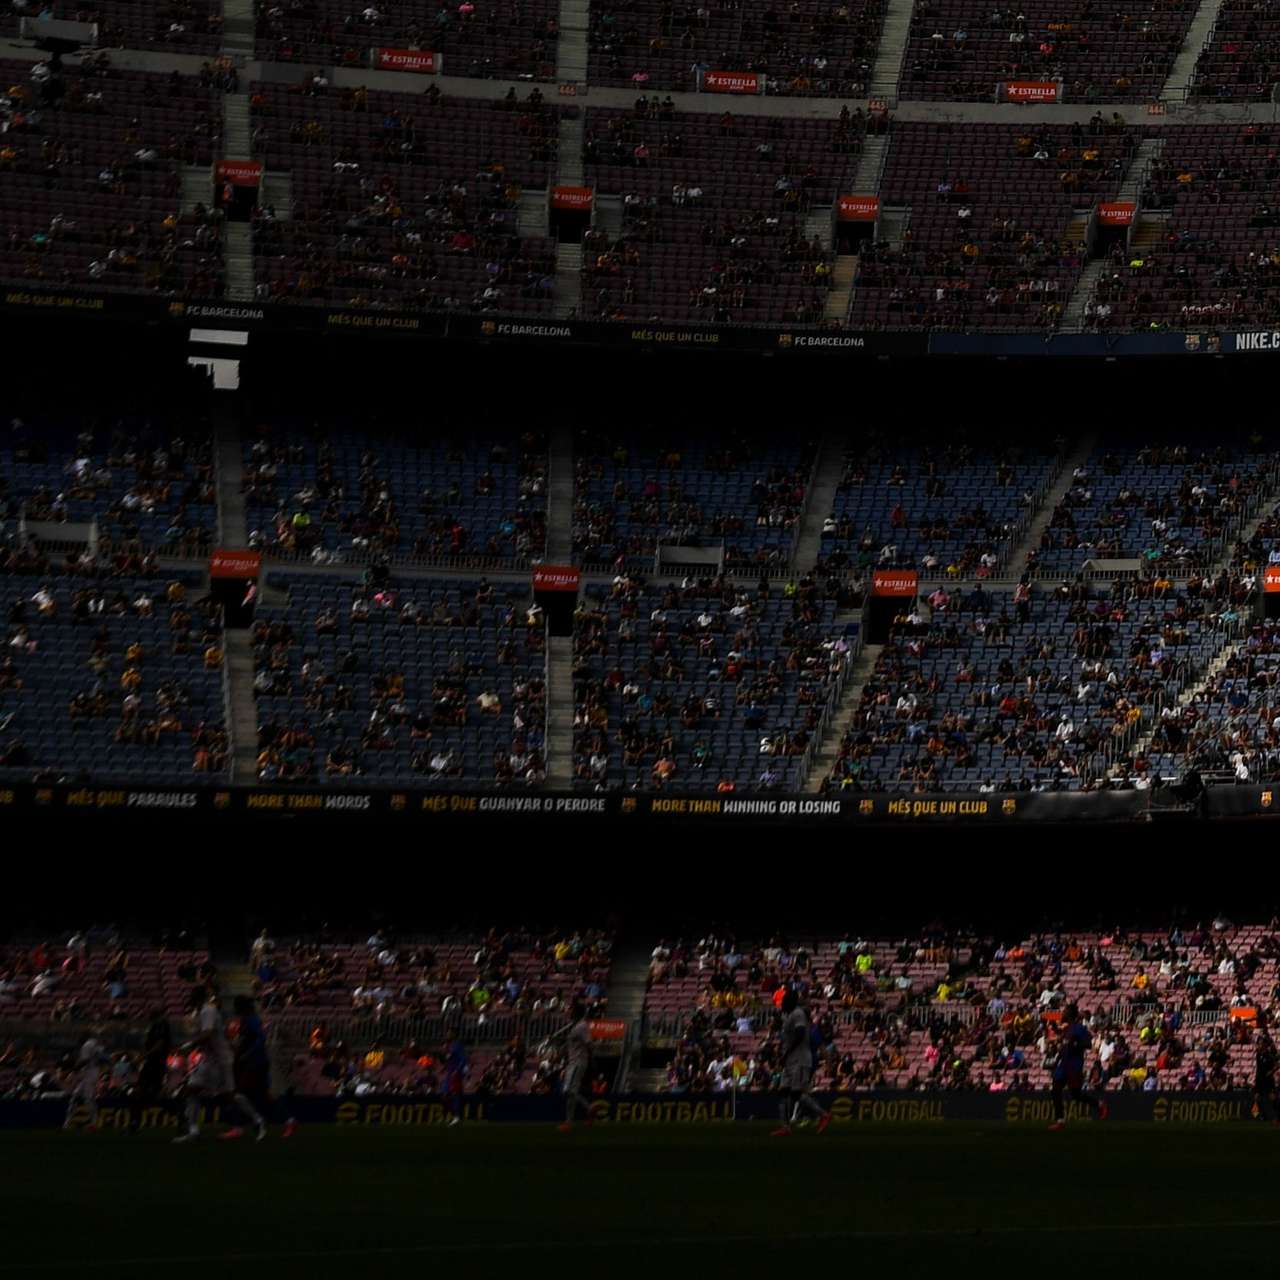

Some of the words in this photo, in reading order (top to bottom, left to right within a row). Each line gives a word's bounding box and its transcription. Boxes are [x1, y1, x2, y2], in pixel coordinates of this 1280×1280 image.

[718, 77, 757, 87] ESTRELLA
[1019, 87, 1056, 96] ESTRELLA
[498, 323, 511, 334] FC
[512, 324, 572, 337] BARCELONA
[795, 335, 808, 345] FC
[808, 337, 865, 348] BARCELONA
[652, 799, 687, 814] MORE
[688, 799, 721, 814] THAN
[723, 799, 777, 814] WINNING
[779, 800, 797, 814] OR
[799, 800, 841, 814] LOSING
[888, 798, 911, 814] MÉS
[913, 800, 937, 816] QUE
[940, 800, 957, 814] UN
[959, 800, 988, 814] CLUB
